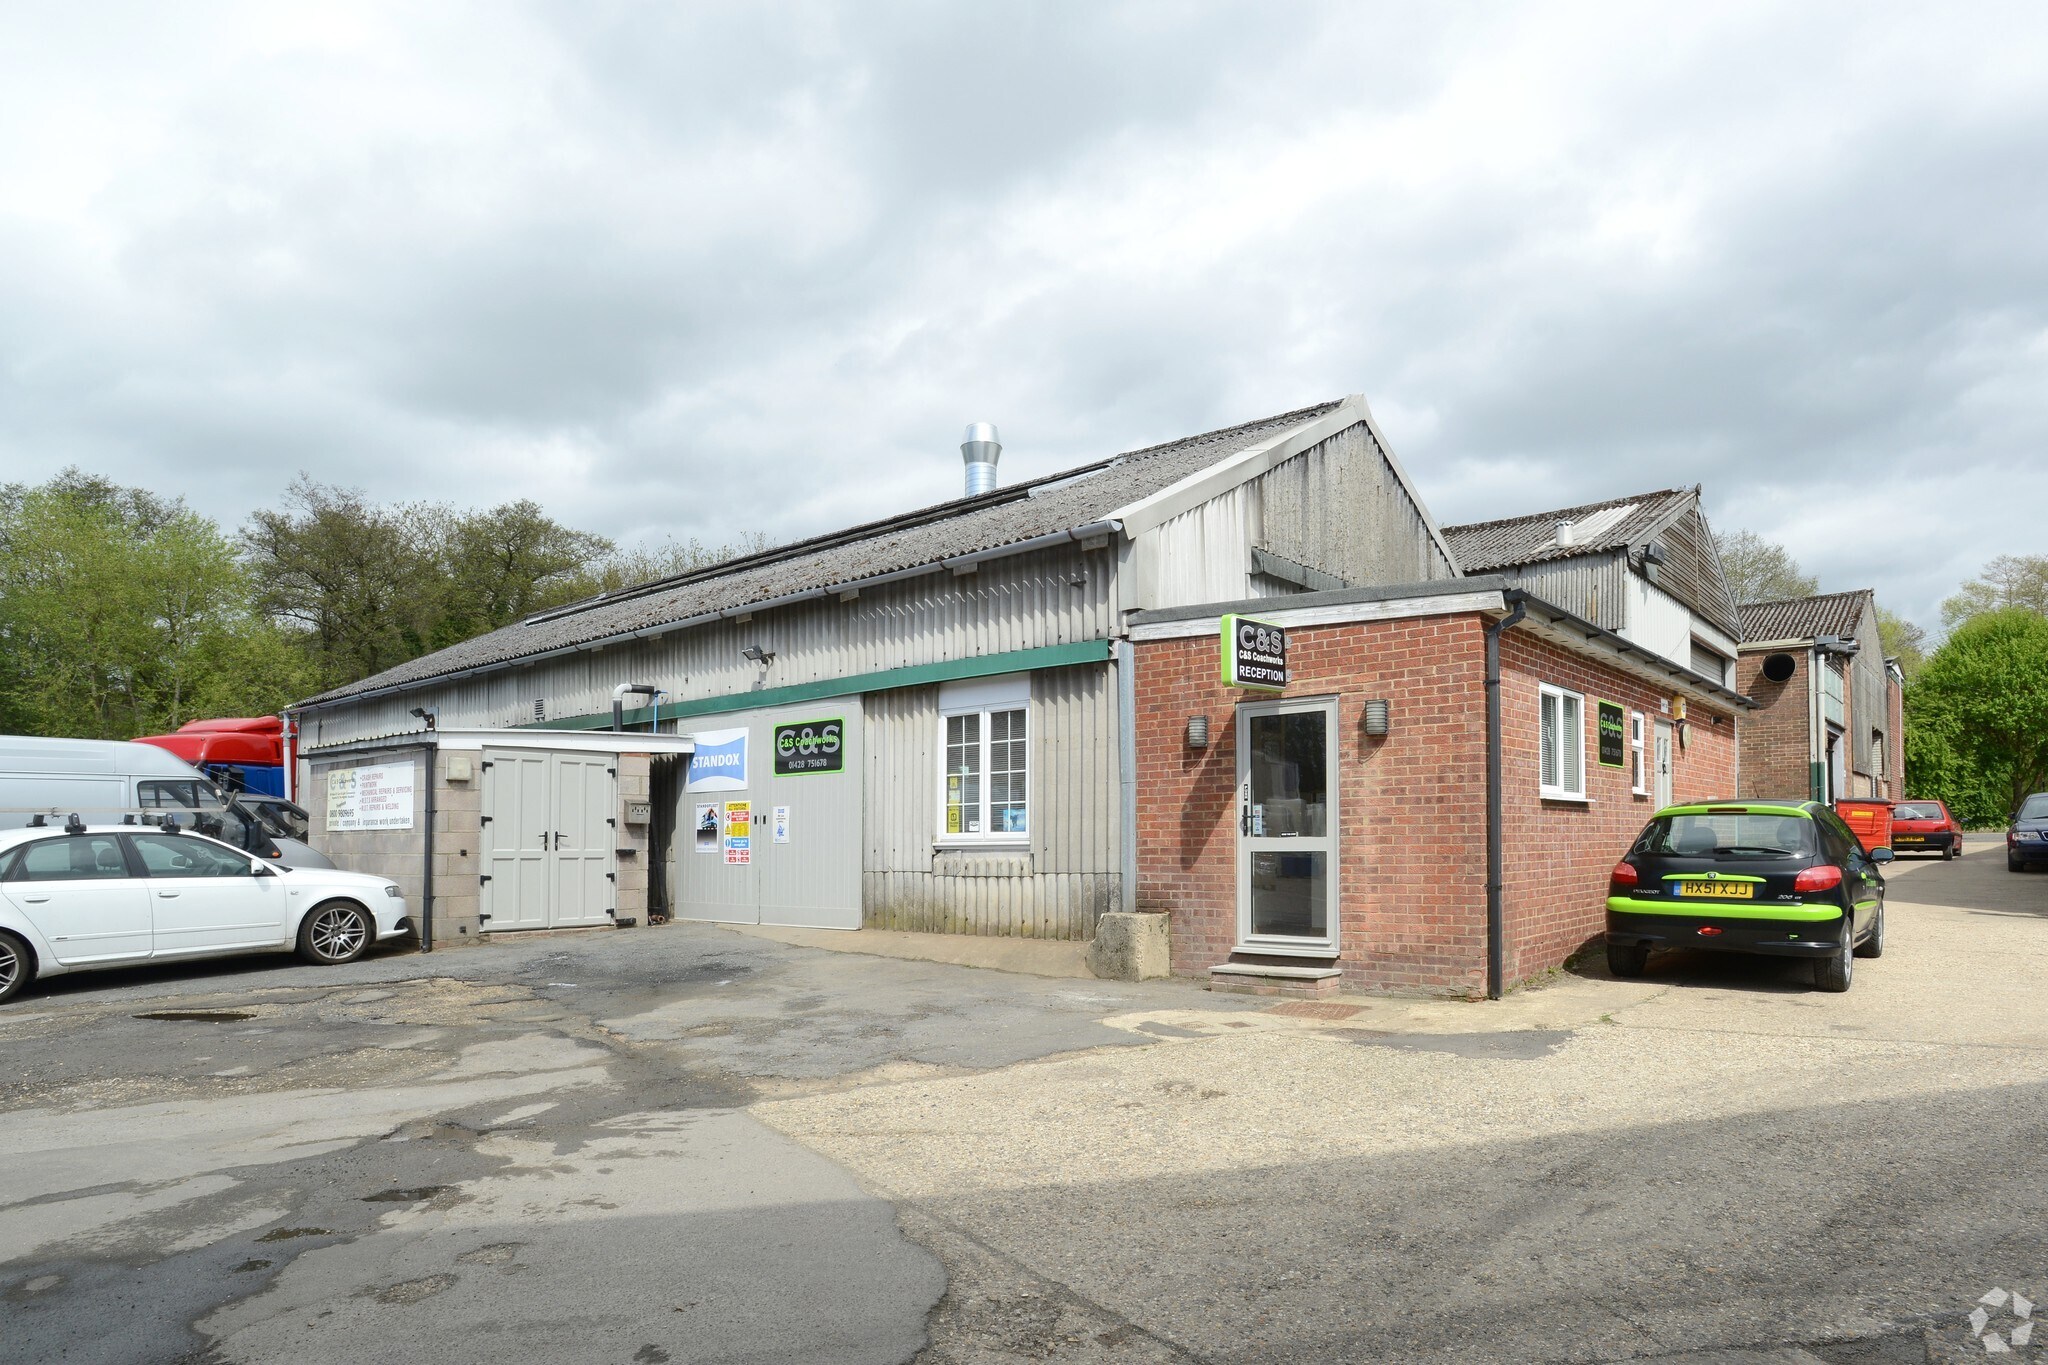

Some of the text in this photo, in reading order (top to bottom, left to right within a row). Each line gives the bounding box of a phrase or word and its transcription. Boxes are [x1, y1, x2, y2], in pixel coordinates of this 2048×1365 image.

[1240, 625, 1282, 654] C&S
[1239, 650, 1283, 665] C&S Coachworks
[1239, 666, 1284, 681] RECEPTION
[777, 725, 840, 757] C&S
[780, 734, 838, 748] C&S Coachworks
[692, 753, 740, 769] STANDOX
[788, 758, 827, 769] 01428 751678
[372, 772, 384, 780] REPAIRS
[362, 789, 378, 797] MECHANICAL
[329, 809, 337, 818] 0800
[1685, 882, 1716, 894] HX51
[1719, 884, 1748, 895] XJJ
